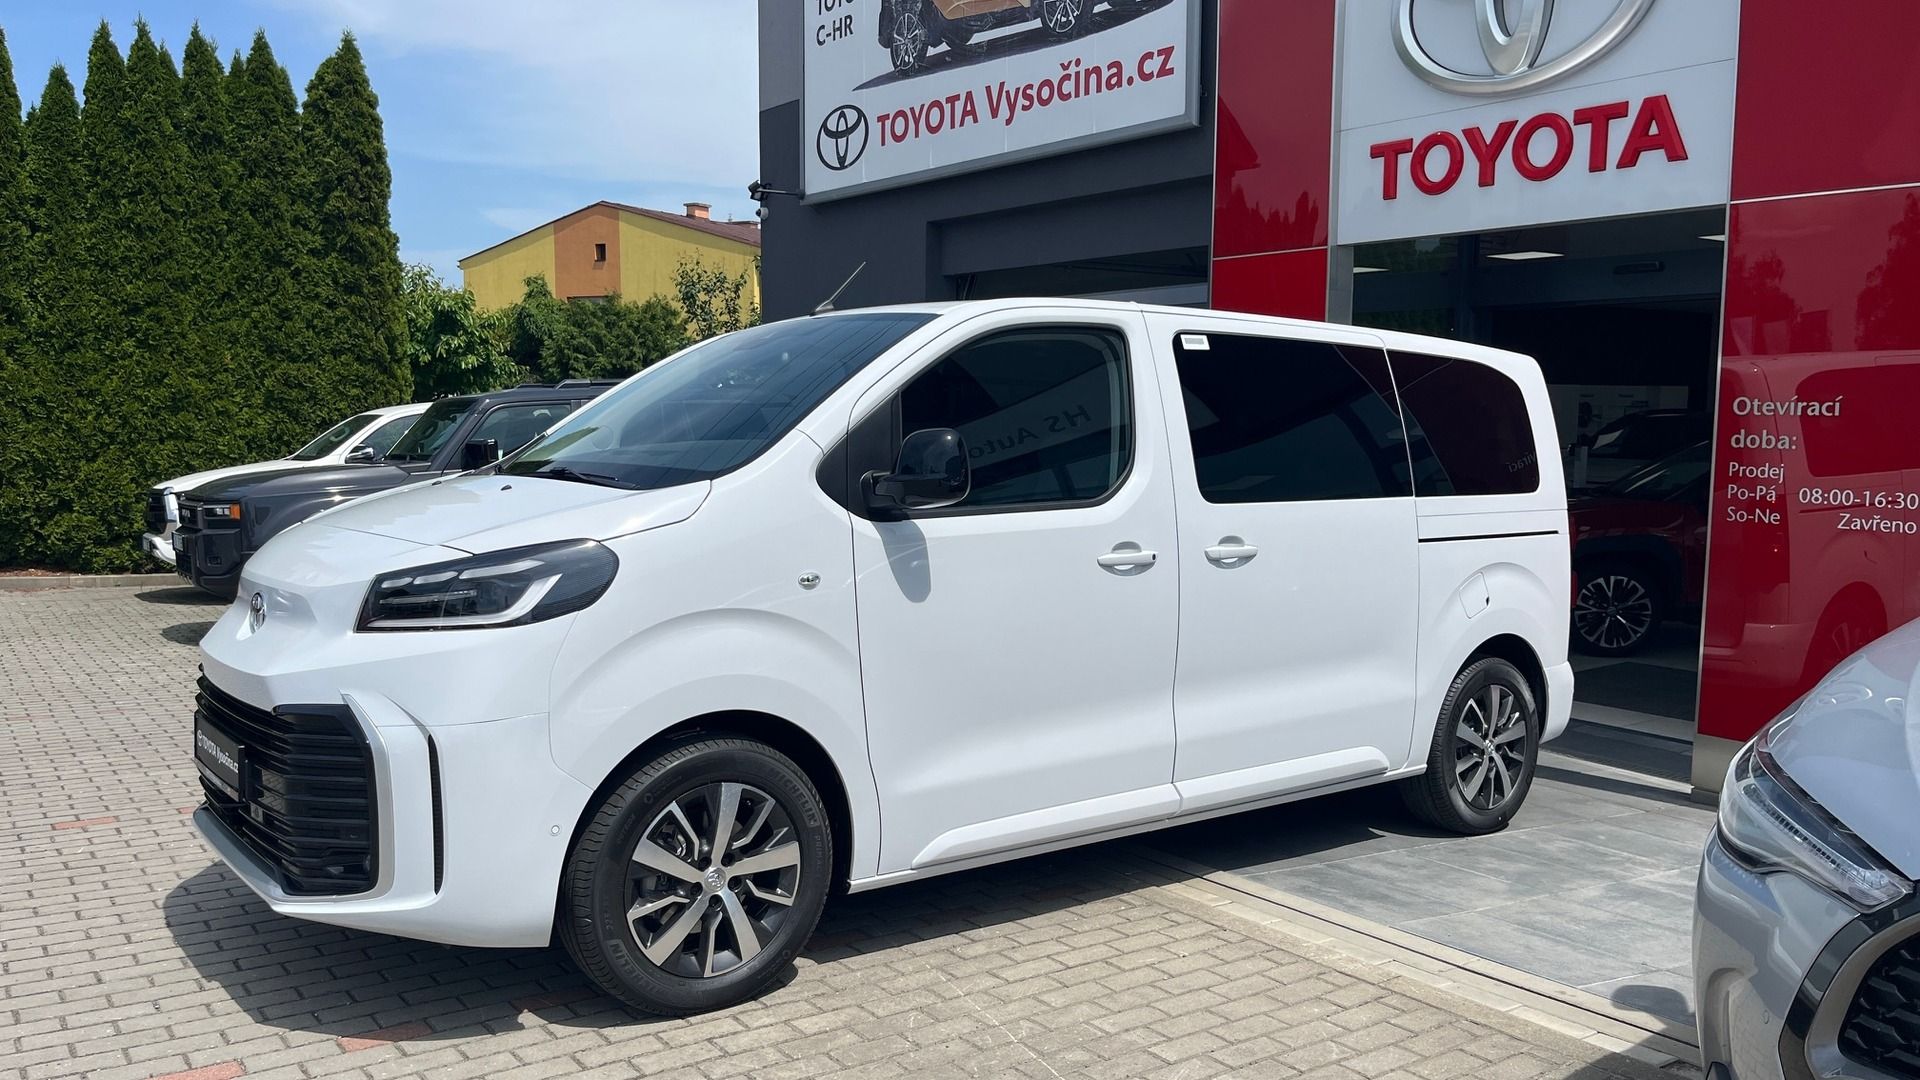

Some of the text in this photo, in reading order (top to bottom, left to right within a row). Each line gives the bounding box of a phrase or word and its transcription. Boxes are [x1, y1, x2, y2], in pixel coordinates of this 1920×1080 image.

[816, 0, 854, 15] TO
[816, 15, 853, 46] C-HR
[877, 45, 1175, 146] TOYOTA Vysočina.cz
[1370, 94, 1688, 200] TOYOTA
[1732, 395, 1843, 416] Otevírací
[1731, 429, 1797, 450] doba:
[1728, 461, 1785, 484] Prodej
[1727, 484, 1919, 510] Po-Pá 08:00-16:30
[1726, 506, 1917, 534] So-Ne Zavřeno
